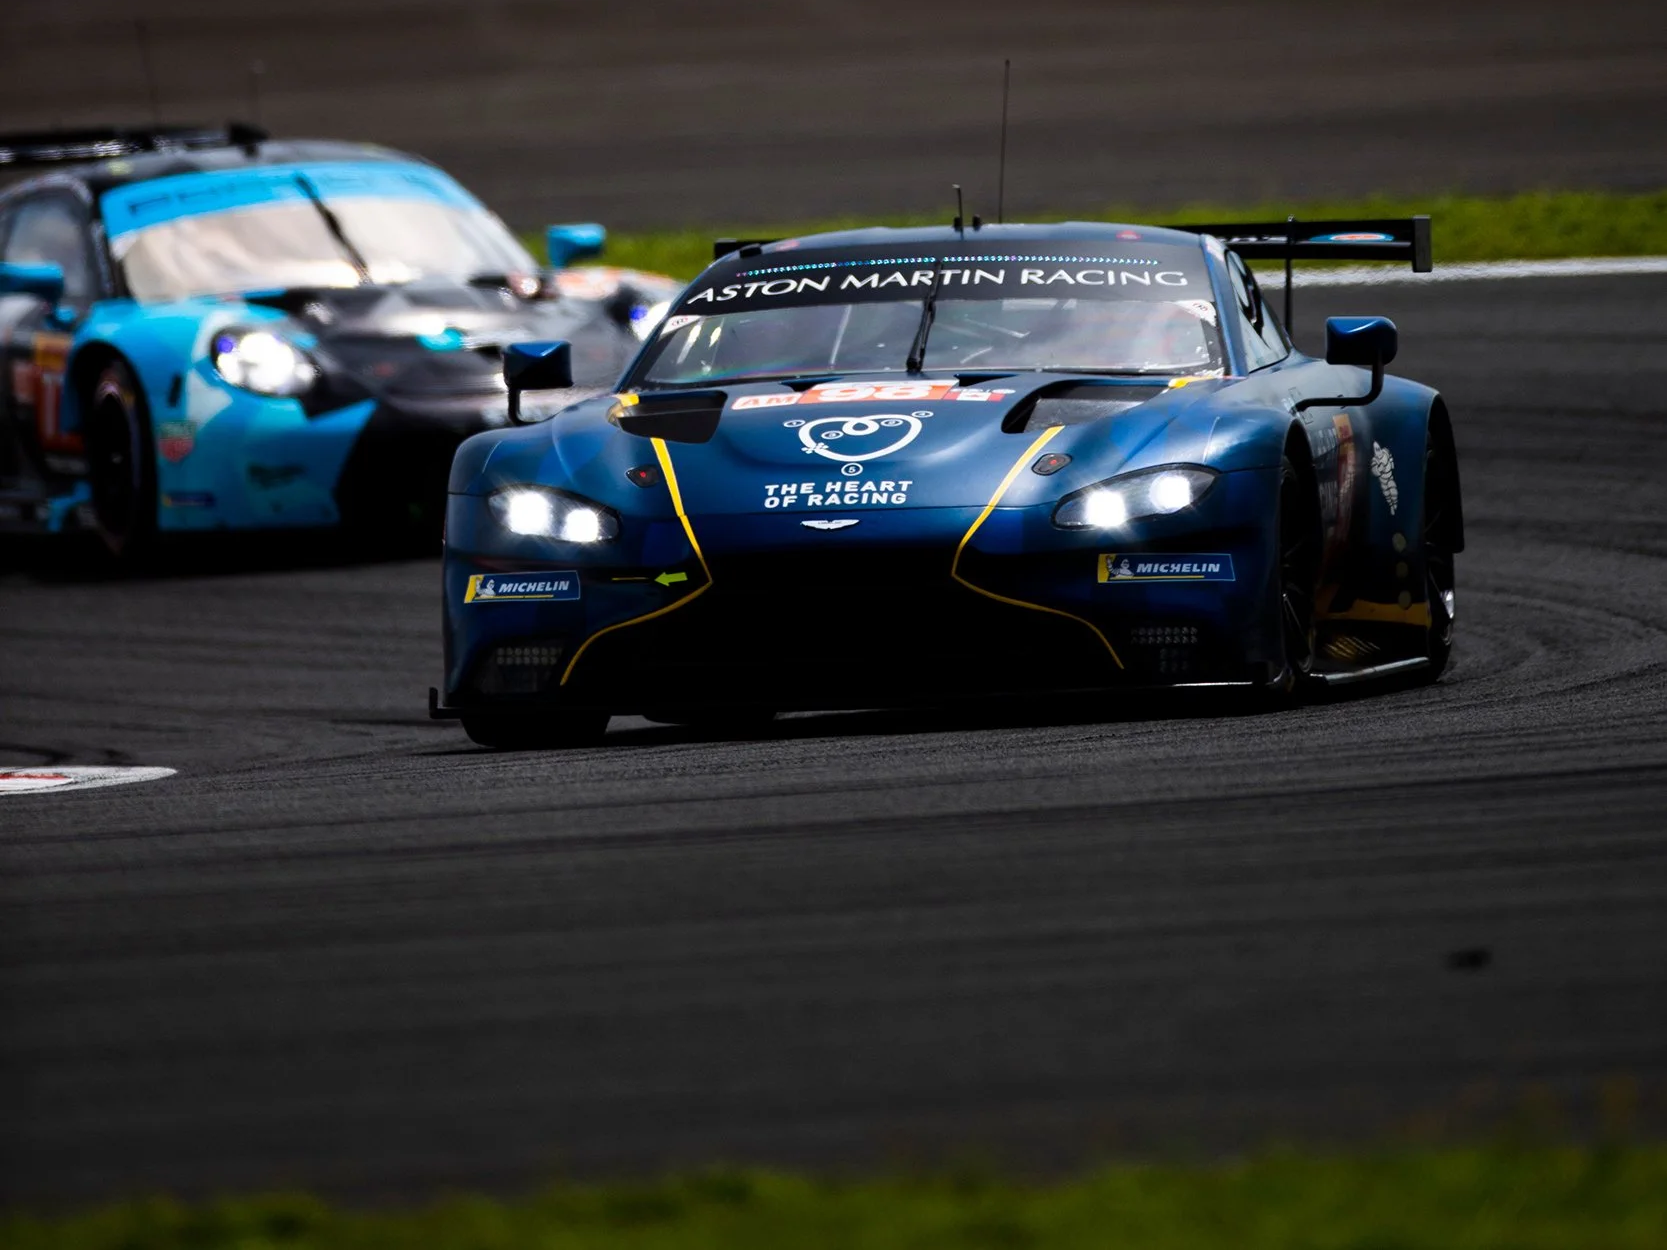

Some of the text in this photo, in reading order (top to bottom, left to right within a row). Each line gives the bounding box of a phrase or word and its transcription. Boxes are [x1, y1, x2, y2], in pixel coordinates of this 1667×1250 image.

[687, 268, 1188, 304] ASTON MARTIN RACING
[740, 384, 932, 407] AM 98
[764, 480, 913, 496] THE HEART
[764, 492, 907, 508] OF RACING
[1136, 563, 1220, 573] MICHELIN
[498, 580, 570, 593] MICHELIN
